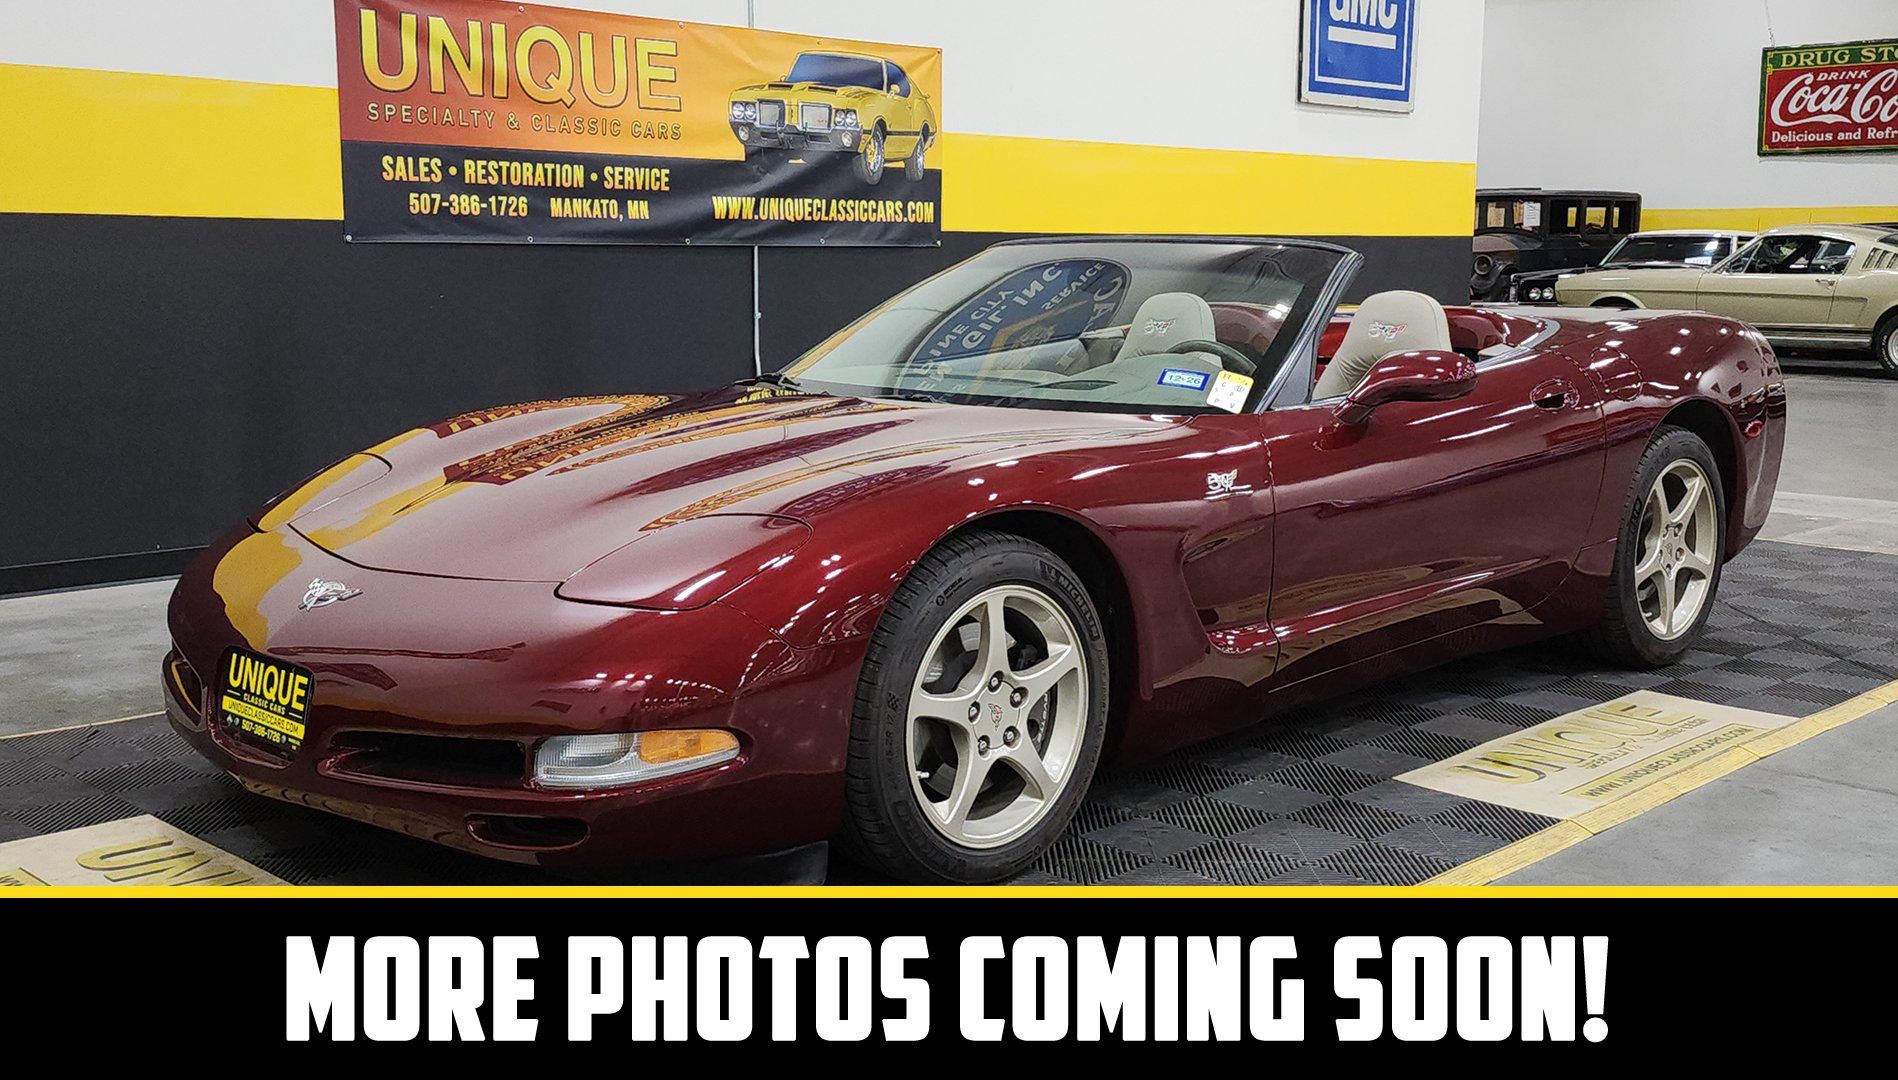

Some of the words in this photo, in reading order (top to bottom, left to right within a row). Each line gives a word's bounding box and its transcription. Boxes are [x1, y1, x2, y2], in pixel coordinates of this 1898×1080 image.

[359, 8, 682, 112] UNIQUE
[1781, 50, 1850, 67] DRUG
[1861, 47, 1898, 62] ST
[1817, 70, 1870, 81] DRINK
[367, 102, 496, 129] SPECIALTY
[507, 113, 522, 130] &
[530, 114, 622, 137] CLASSIC
[631, 121, 682, 141] CARS
[1771, 130, 1833, 143] Delicious
[1837, 128, 1861, 140] and
[381, 155, 443, 183] SALES
[464, 159, 585, 188] RESTORATION
[603, 165, 671, 191] SERVICE
[408, 192, 528, 217] 507-386-1726
[550, 197, 624, 222] MANKATO,
[627, 200, 650, 220] MN
[712, 196, 934, 223] WWW.UNIQUECLASSICCARS.COM
[1059, 575, 1099, 637] MICHELIN
[229, 653, 309, 711] UNIQUE
[243, 693, 268, 709] CLASSIC
[269, 701, 286, 715] CARS
[1453, 702, 1696, 785] UNIQUE
